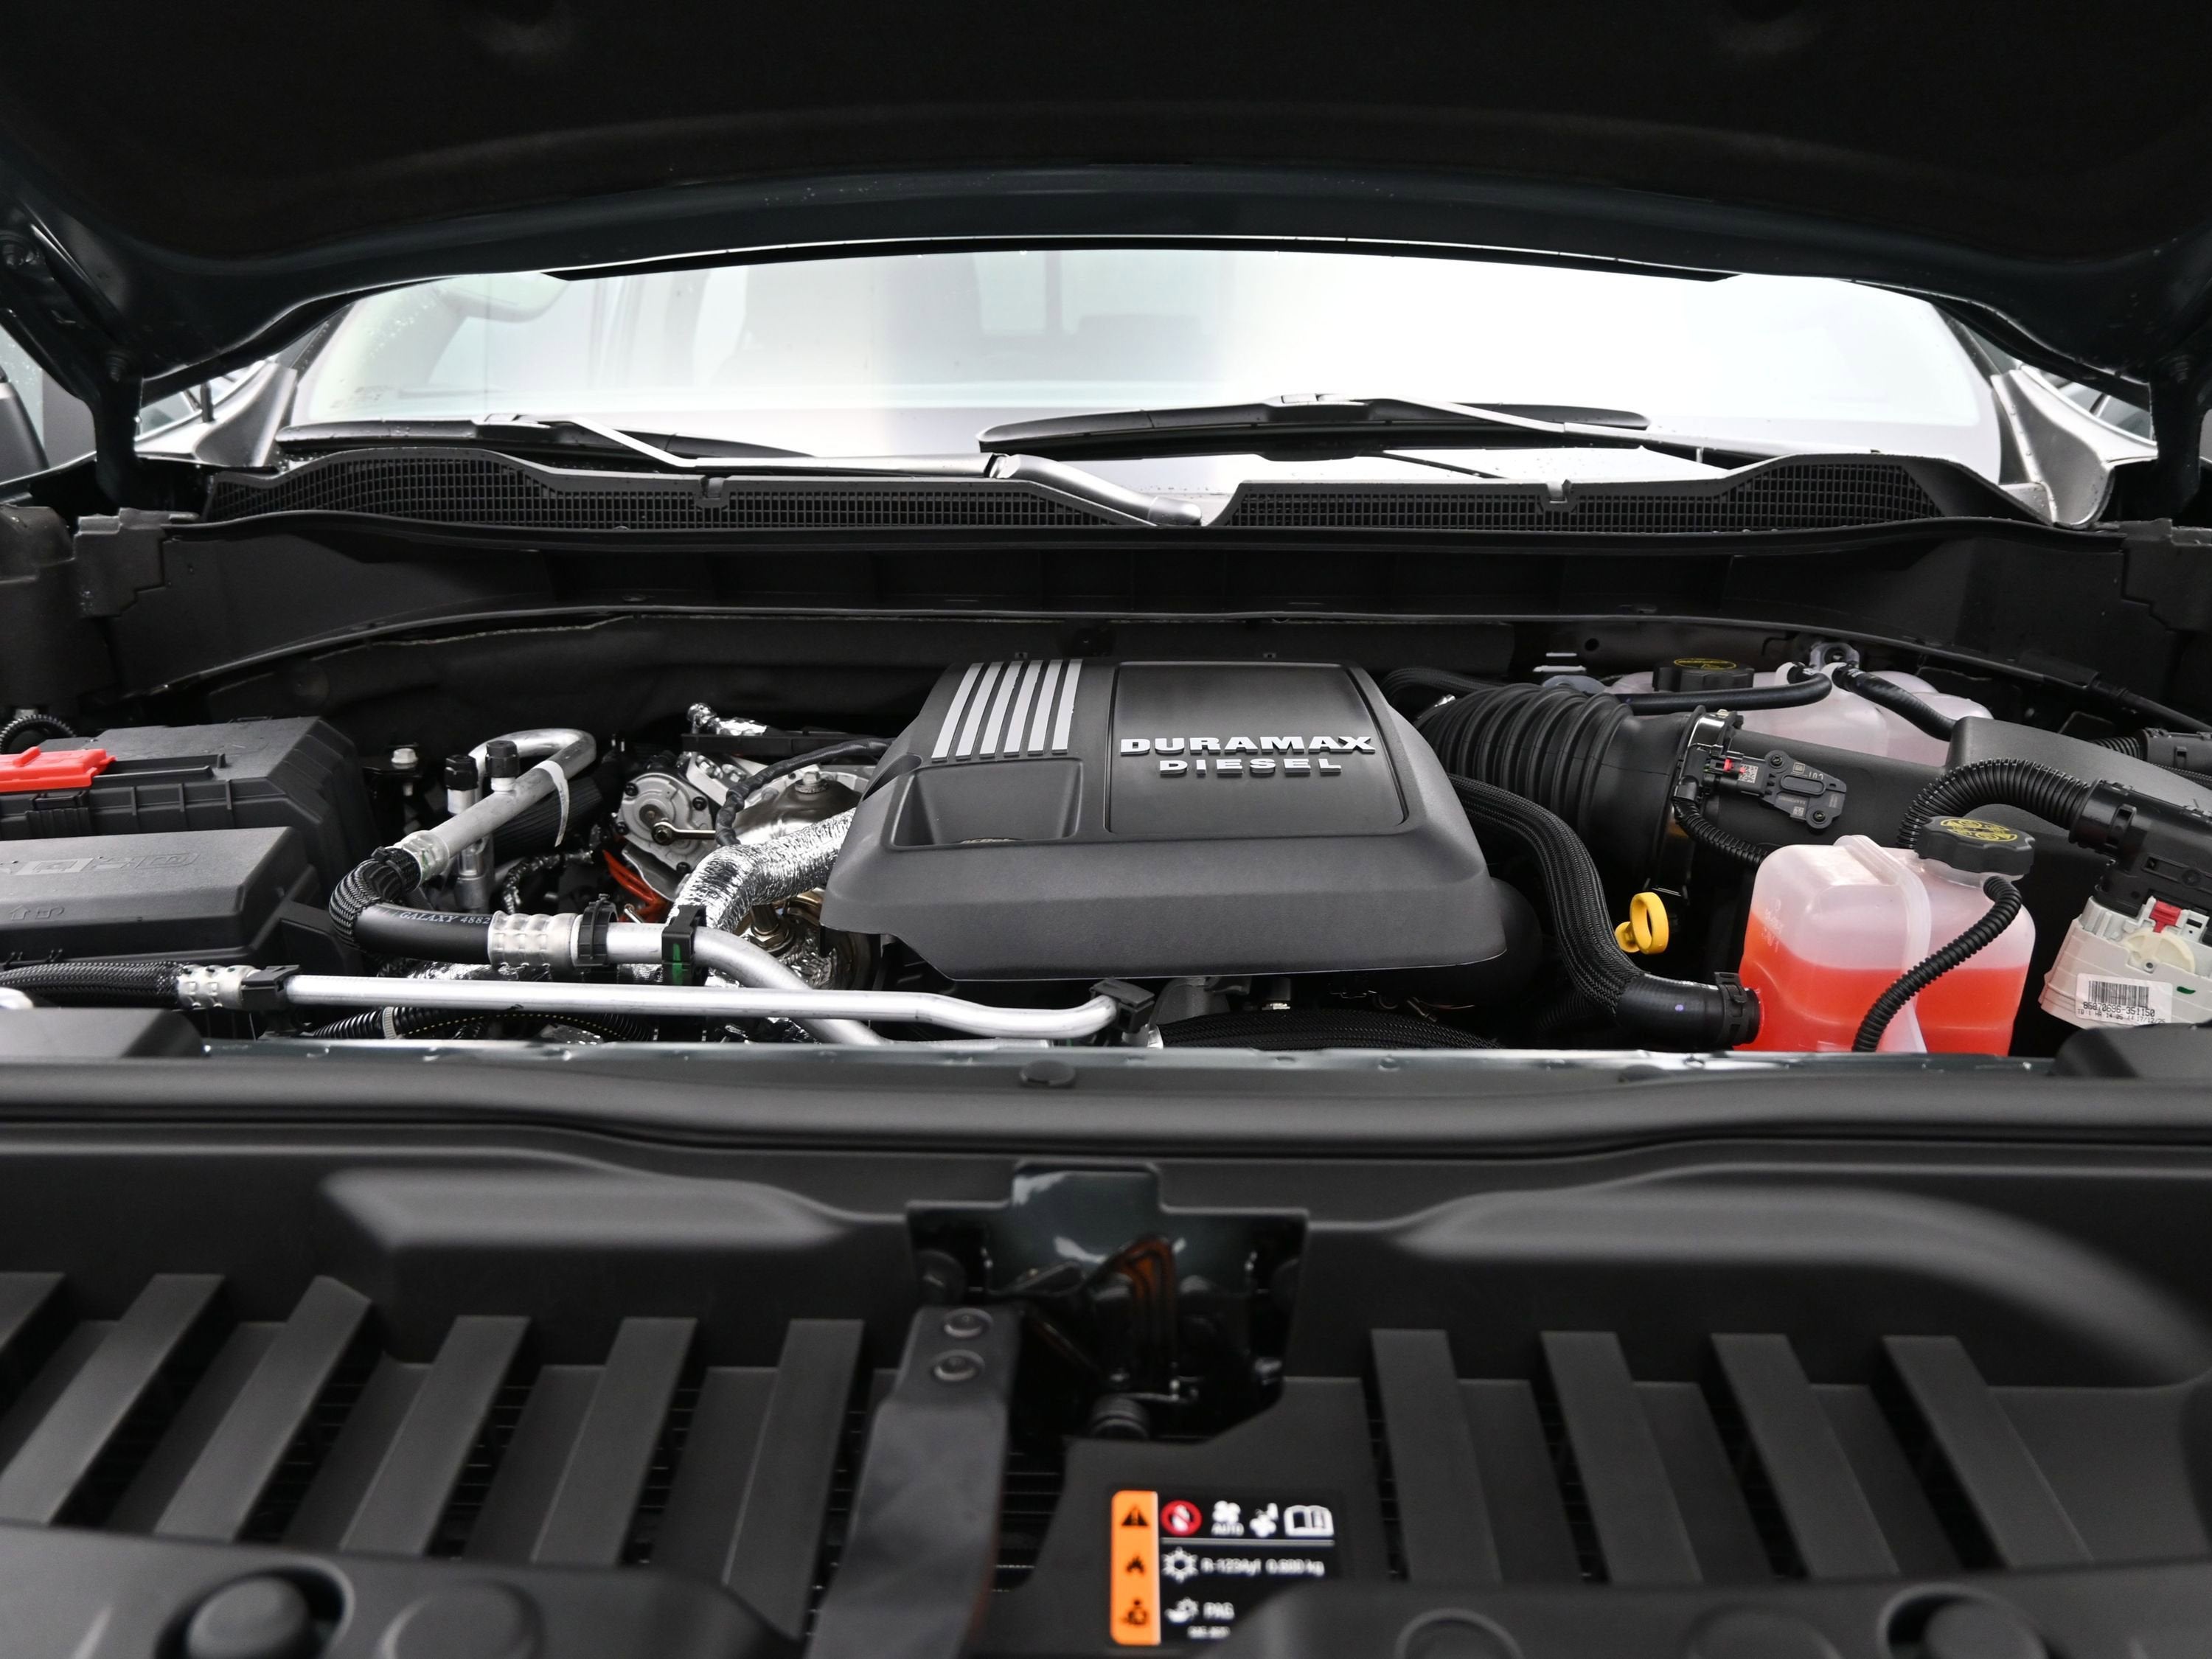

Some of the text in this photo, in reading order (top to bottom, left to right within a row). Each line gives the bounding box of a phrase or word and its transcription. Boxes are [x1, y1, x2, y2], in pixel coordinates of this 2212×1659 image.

[1120, 736, 1376, 756] DURAMAX
[1159, 758, 1342, 775] DIESEL
[400, 911, 459, 922] GALAXY
